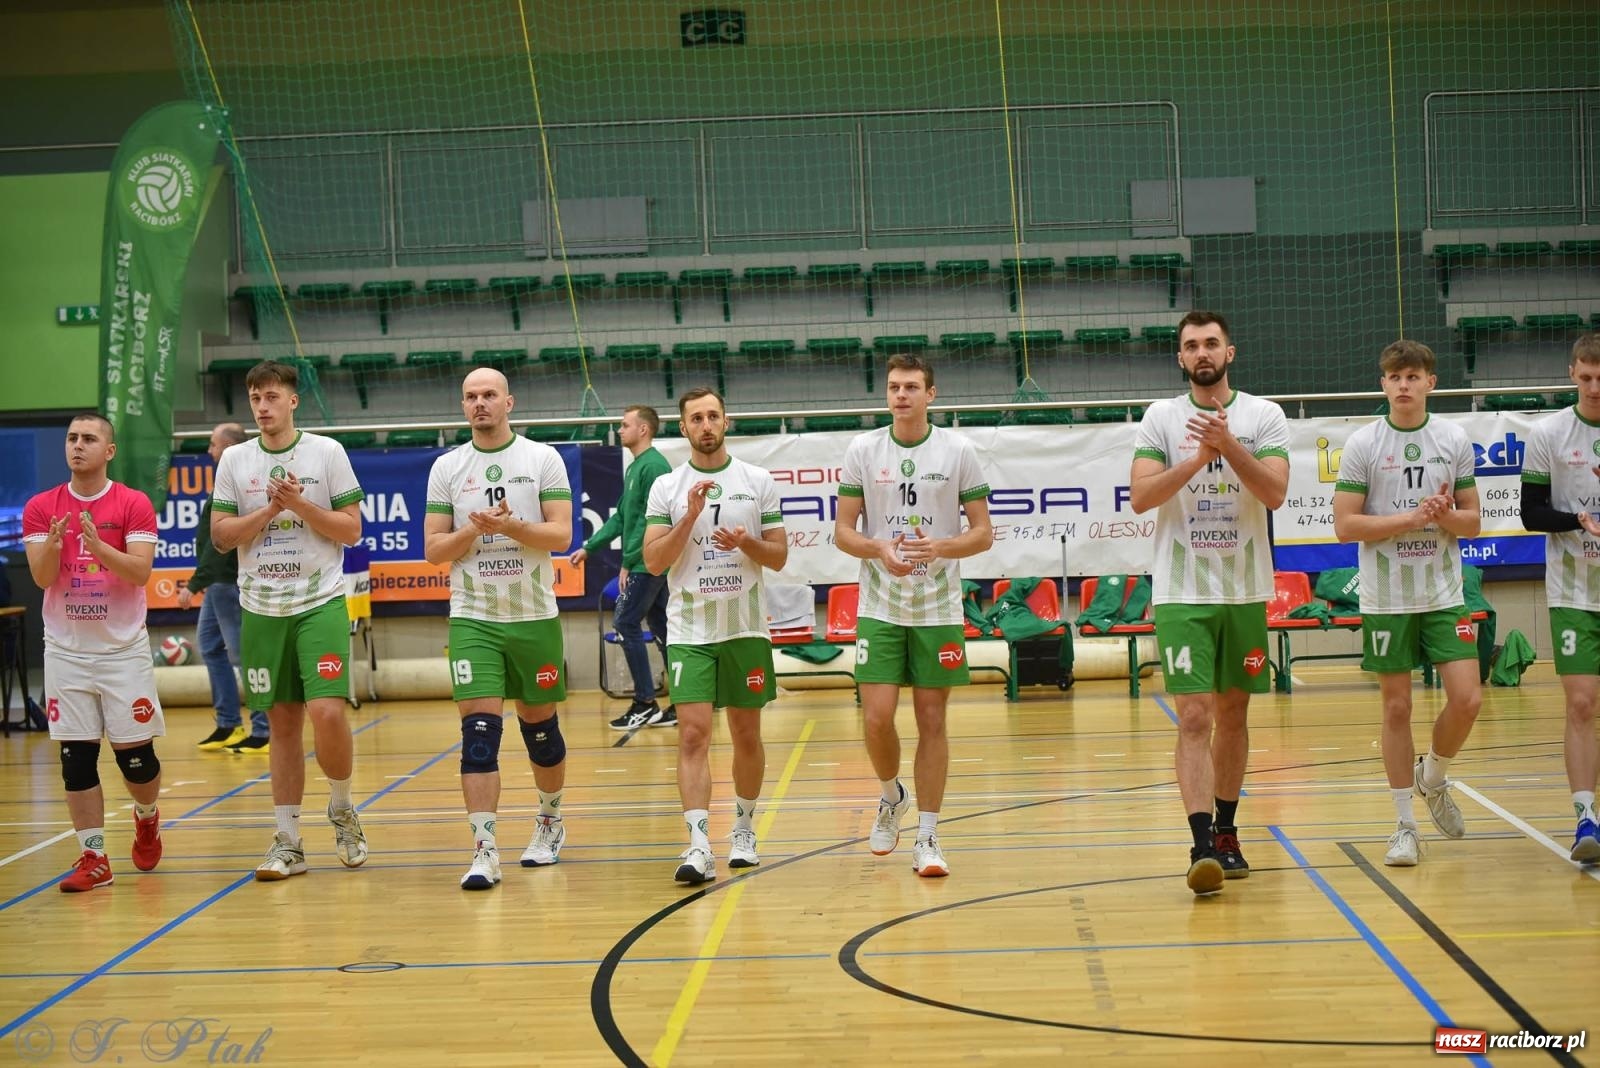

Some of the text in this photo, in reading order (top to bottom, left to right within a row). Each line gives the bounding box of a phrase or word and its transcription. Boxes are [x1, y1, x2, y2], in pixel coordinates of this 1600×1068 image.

[128, 152, 193, 197] KLUB SIATKARSKI
[106, 241, 133, 385] SIATKARSKI
[1403, 465, 1425, 490] 17
[899, 482, 918, 507] 16
[1187, 483, 1240, 494] VISON
[1486, 489, 1509, 500] 606
[1287, 496, 1326, 509] tel. 32
[709, 503, 721, 526] 7
[885, 515, 933, 526] VISON
[1297, 514, 1335, 527] 47-40
[1049, 523, 1076, 539] FM
[1088, 520, 1156, 539] OLESNO
[1190, 530, 1238, 541] PIVEXIN
[155, 538, 197, 558] Raci
[382, 531, 409, 551] 55
[1191, 541, 1238, 549] TECHNOLOGY
[258, 562, 301, 573] PIVEXIN
[478, 559, 524, 571] PIVEXIN
[479, 569, 524, 578] TECHNOLOGY
[699, 575, 742, 587] PIVEXIN
[700, 585, 742, 594] TECHNOLOGY
[65, 604, 108, 614] PIVEXIN
[1371, 630, 1391, 657] 17
[1561, 629, 1577, 656] 3
[1165, 645, 1194, 676] 14
[248, 667, 271, 694] 99
[452, 659, 473, 686] 19
[671, 661, 683, 687] 7
